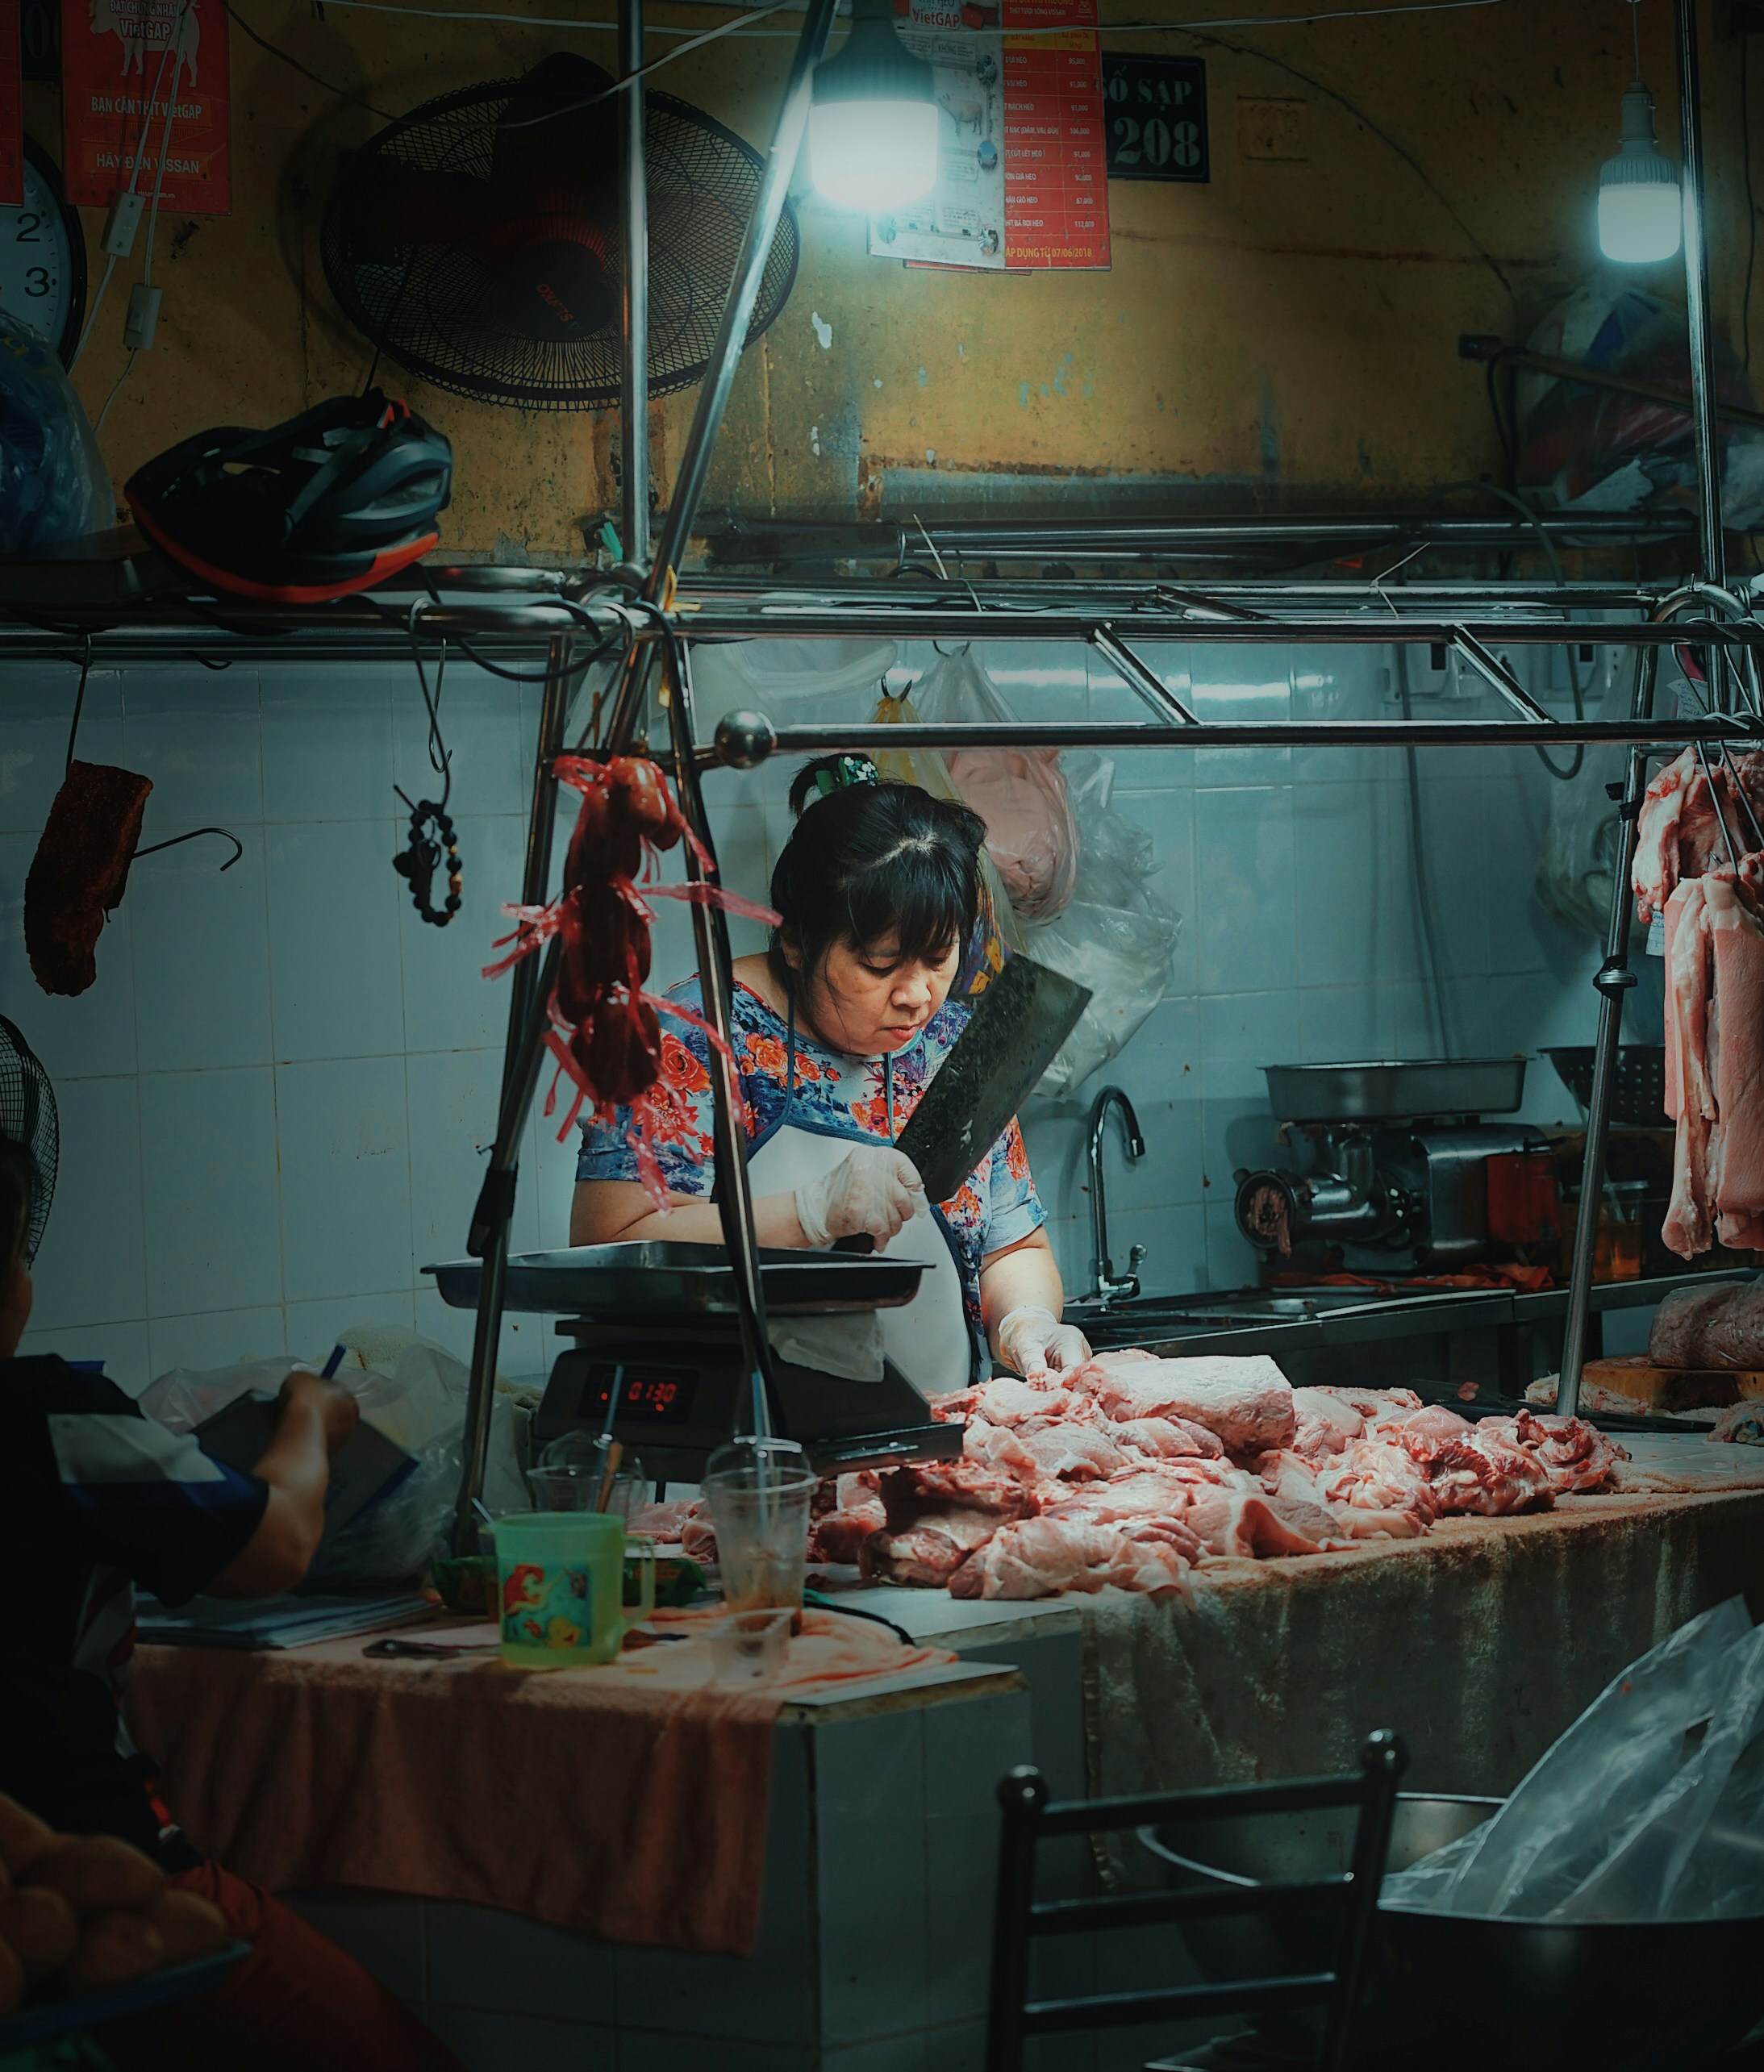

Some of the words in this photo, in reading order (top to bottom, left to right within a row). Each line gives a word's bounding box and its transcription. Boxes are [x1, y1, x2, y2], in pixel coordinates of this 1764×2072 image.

[119, 19, 171, 41] VietGAP
[912, 7, 960, 28] VietGAP
[1137, 77, 1194, 112] SẠP
[91, 95, 113, 116] BẠN
[162, 103, 203, 120] VetGAP
[1113, 116, 1202, 168] 208
[95, 150, 123, 169] HÃY
[16, 213, 40, 242] 2
[1016, 247, 1039, 259] DỤNG
[1052, 247, 1091, 257] 07/06/2018
[24, 267, 49, 297] 3
